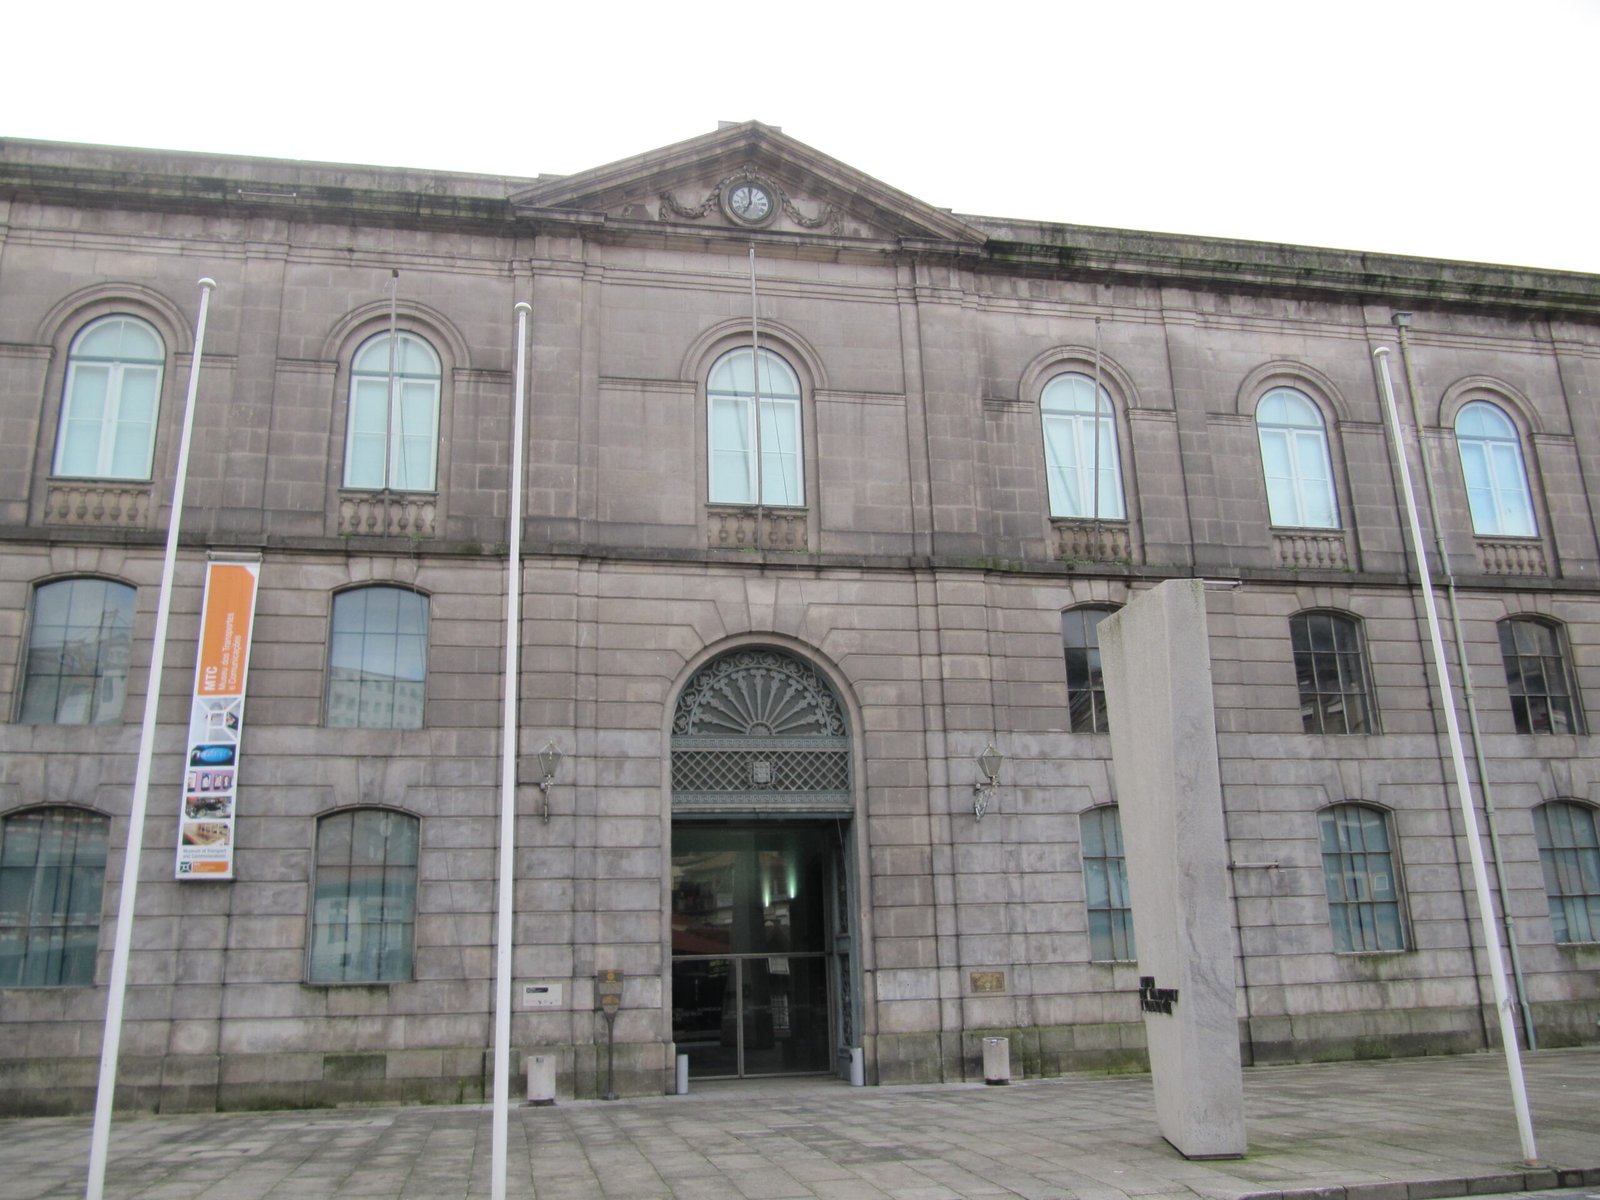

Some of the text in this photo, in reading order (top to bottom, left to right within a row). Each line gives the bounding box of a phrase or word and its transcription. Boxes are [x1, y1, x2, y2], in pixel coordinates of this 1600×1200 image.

[218, 612, 235, 690] Museu dos Transportes
[228, 635, 242, 684] Comunicações
[204, 666, 218, 691] MTC
